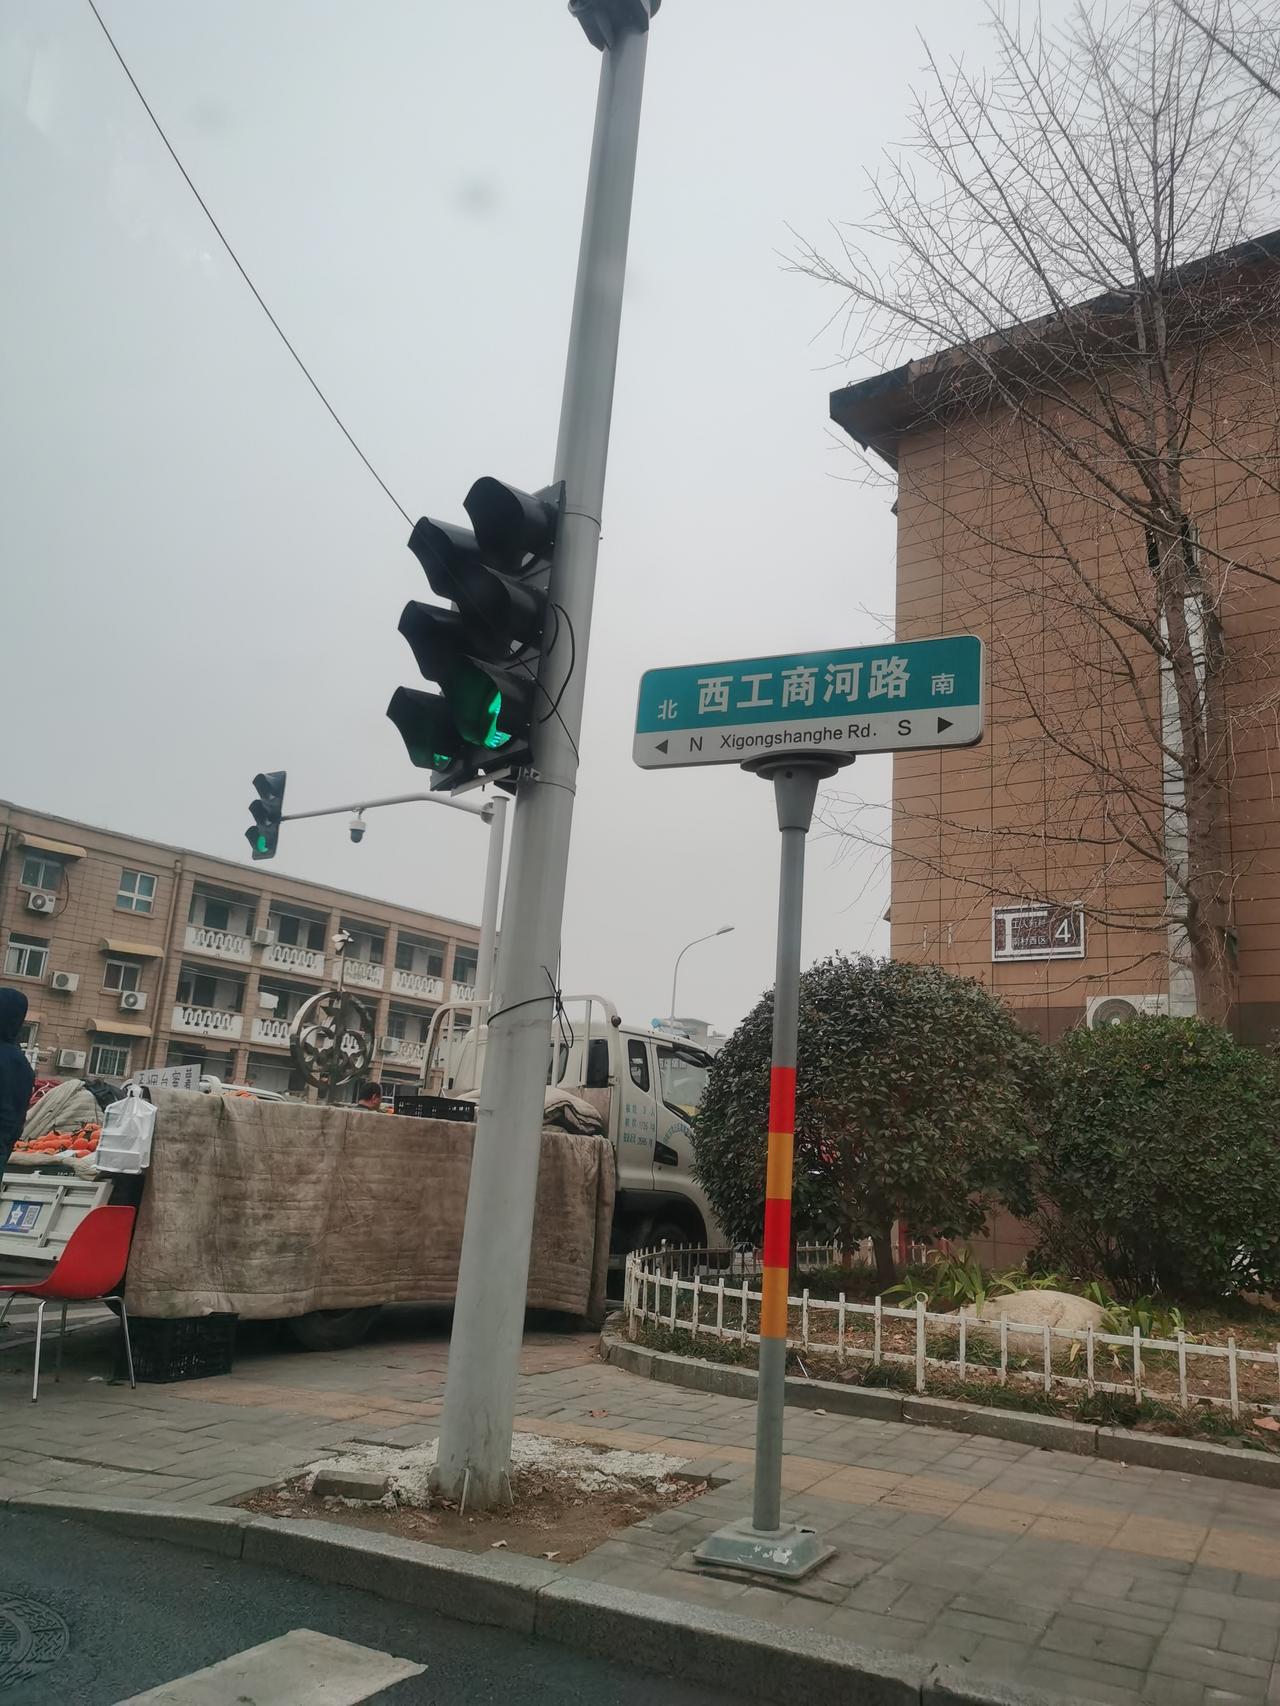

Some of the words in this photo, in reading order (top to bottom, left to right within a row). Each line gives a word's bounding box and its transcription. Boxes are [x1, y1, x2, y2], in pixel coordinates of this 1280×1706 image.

[657, 699, 678, 721] 北
[697, 655, 911, 715] 西工商河路
[931, 673, 956, 697] 南
[689, 736, 703, 752] N
[719, 727, 843, 750] Xigongshanghe
[847, 723, 877, 740] Rd.
[897, 719, 912, 737] S
[1055, 918, 1071, 943] 4
